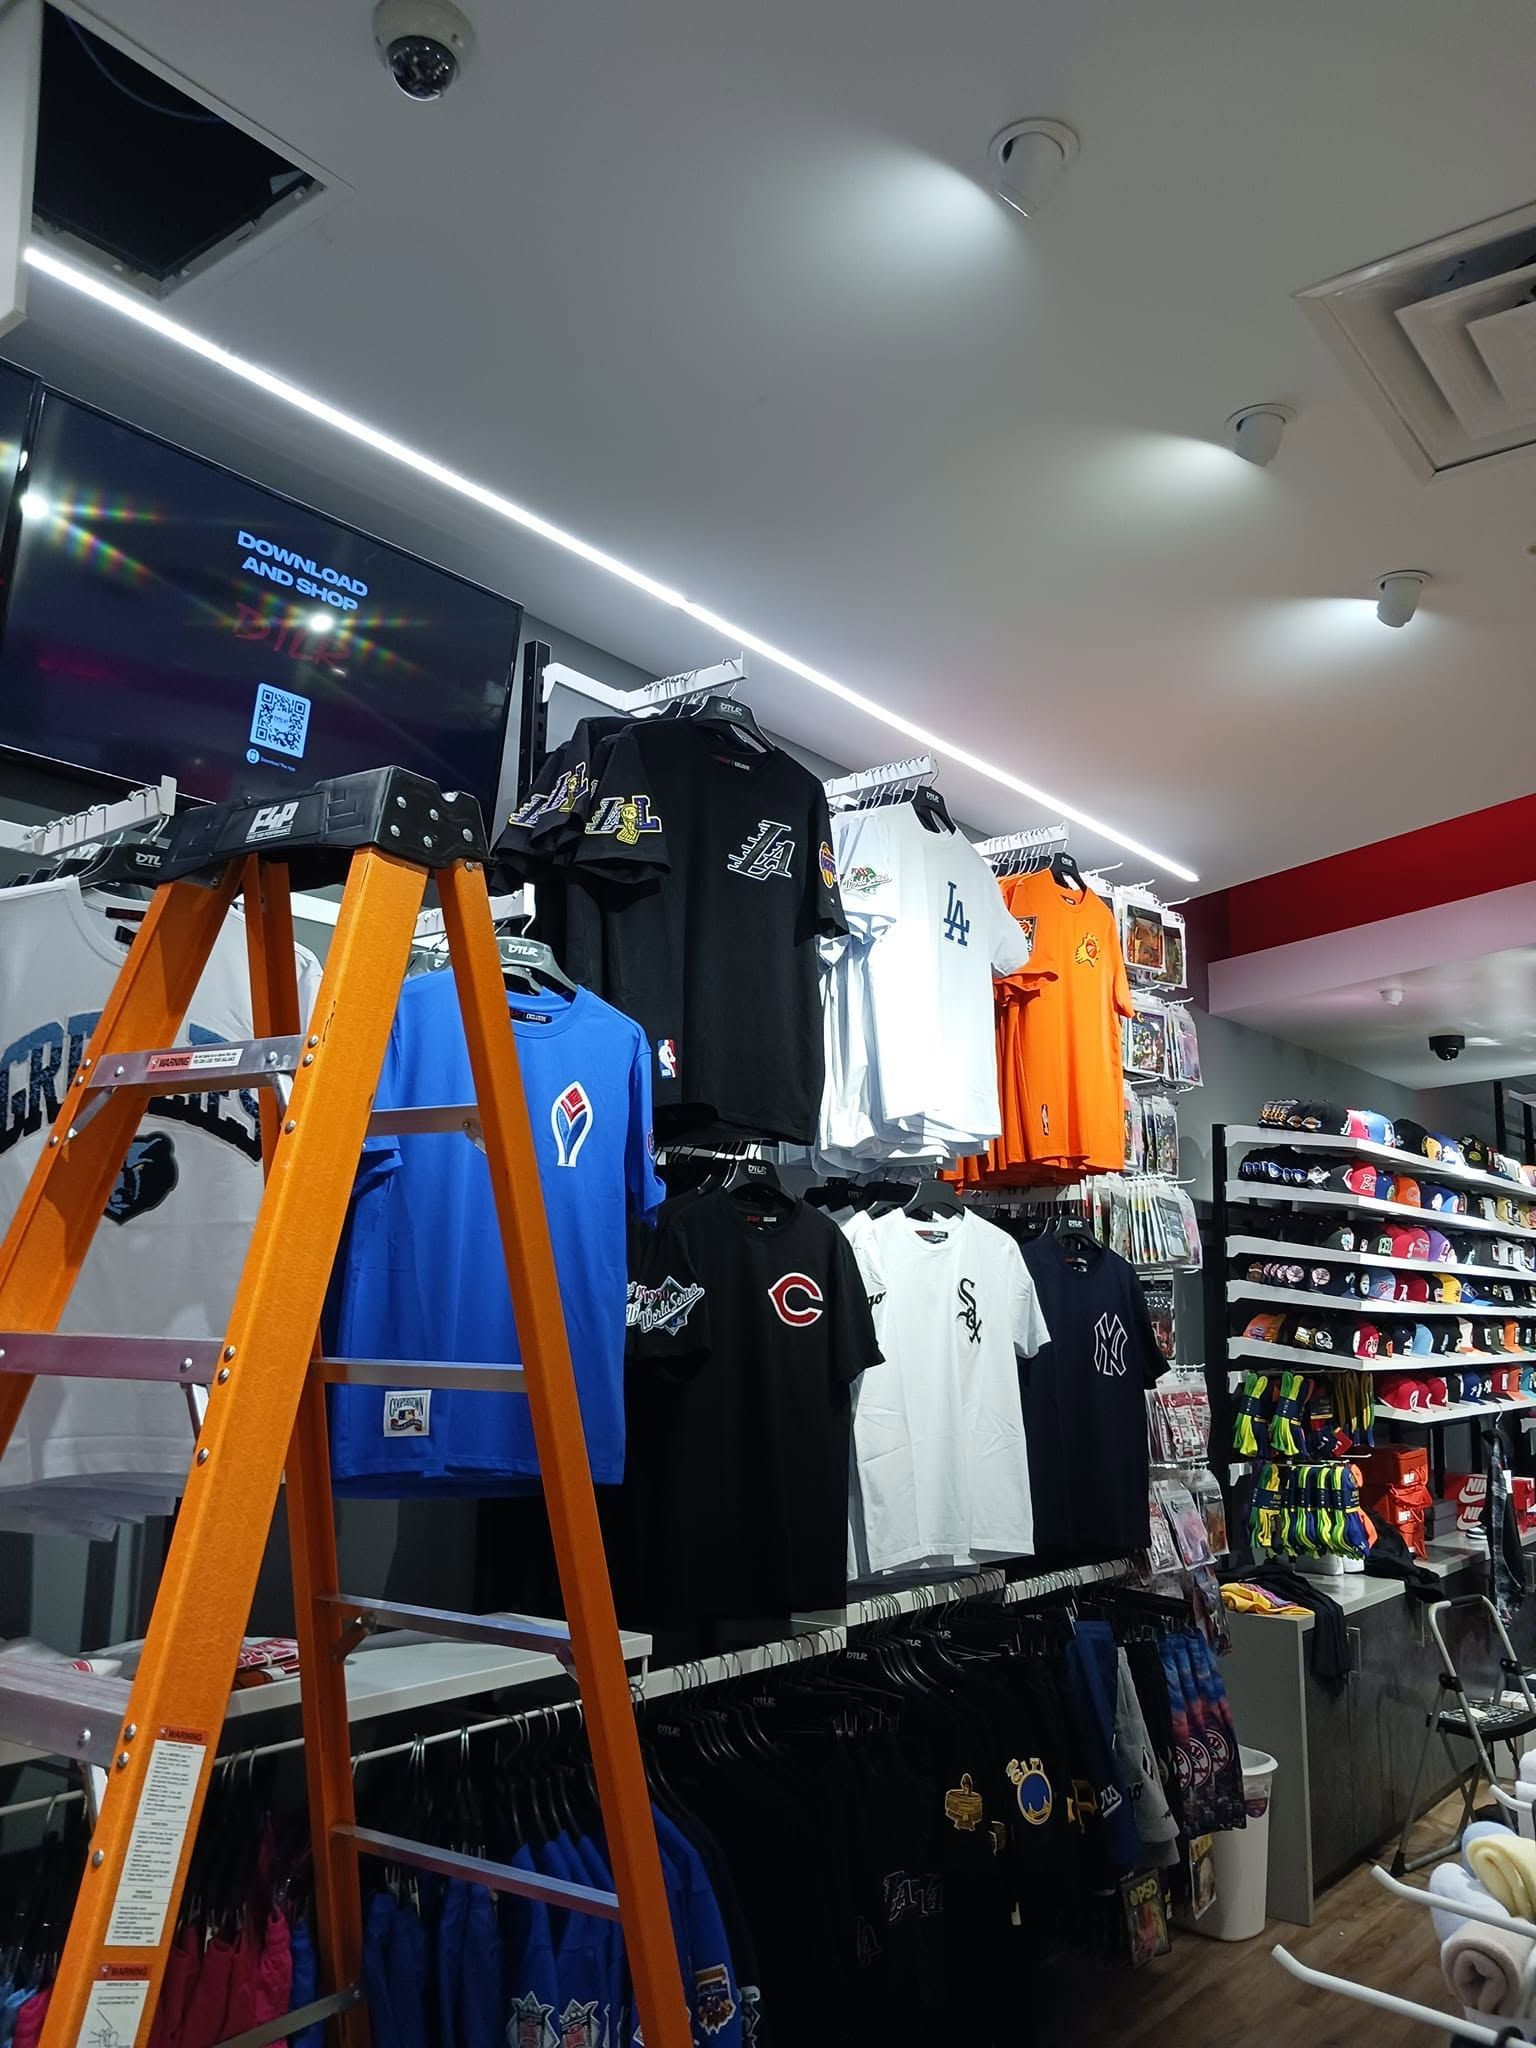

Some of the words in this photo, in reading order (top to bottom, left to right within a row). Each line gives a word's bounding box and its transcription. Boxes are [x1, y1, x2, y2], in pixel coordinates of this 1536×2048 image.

[237, 530, 368, 597] DOWNLOAD
[242, 556, 294, 586] AND
[295, 578, 359, 611] SHOP
[136, 852, 162, 868] DTL
[943, 880, 970, 947] LA
[508, 943, 538, 958] DTLR
[159, 1056, 191, 1067] WARNING
[768, 1272, 824, 1328] C
[956, 1277, 983, 1345] Sox
[1093, 1311, 1129, 1377] NY
[166, 1729, 203, 1742] WARNING
[110, 1965, 149, 1978] WARNING
